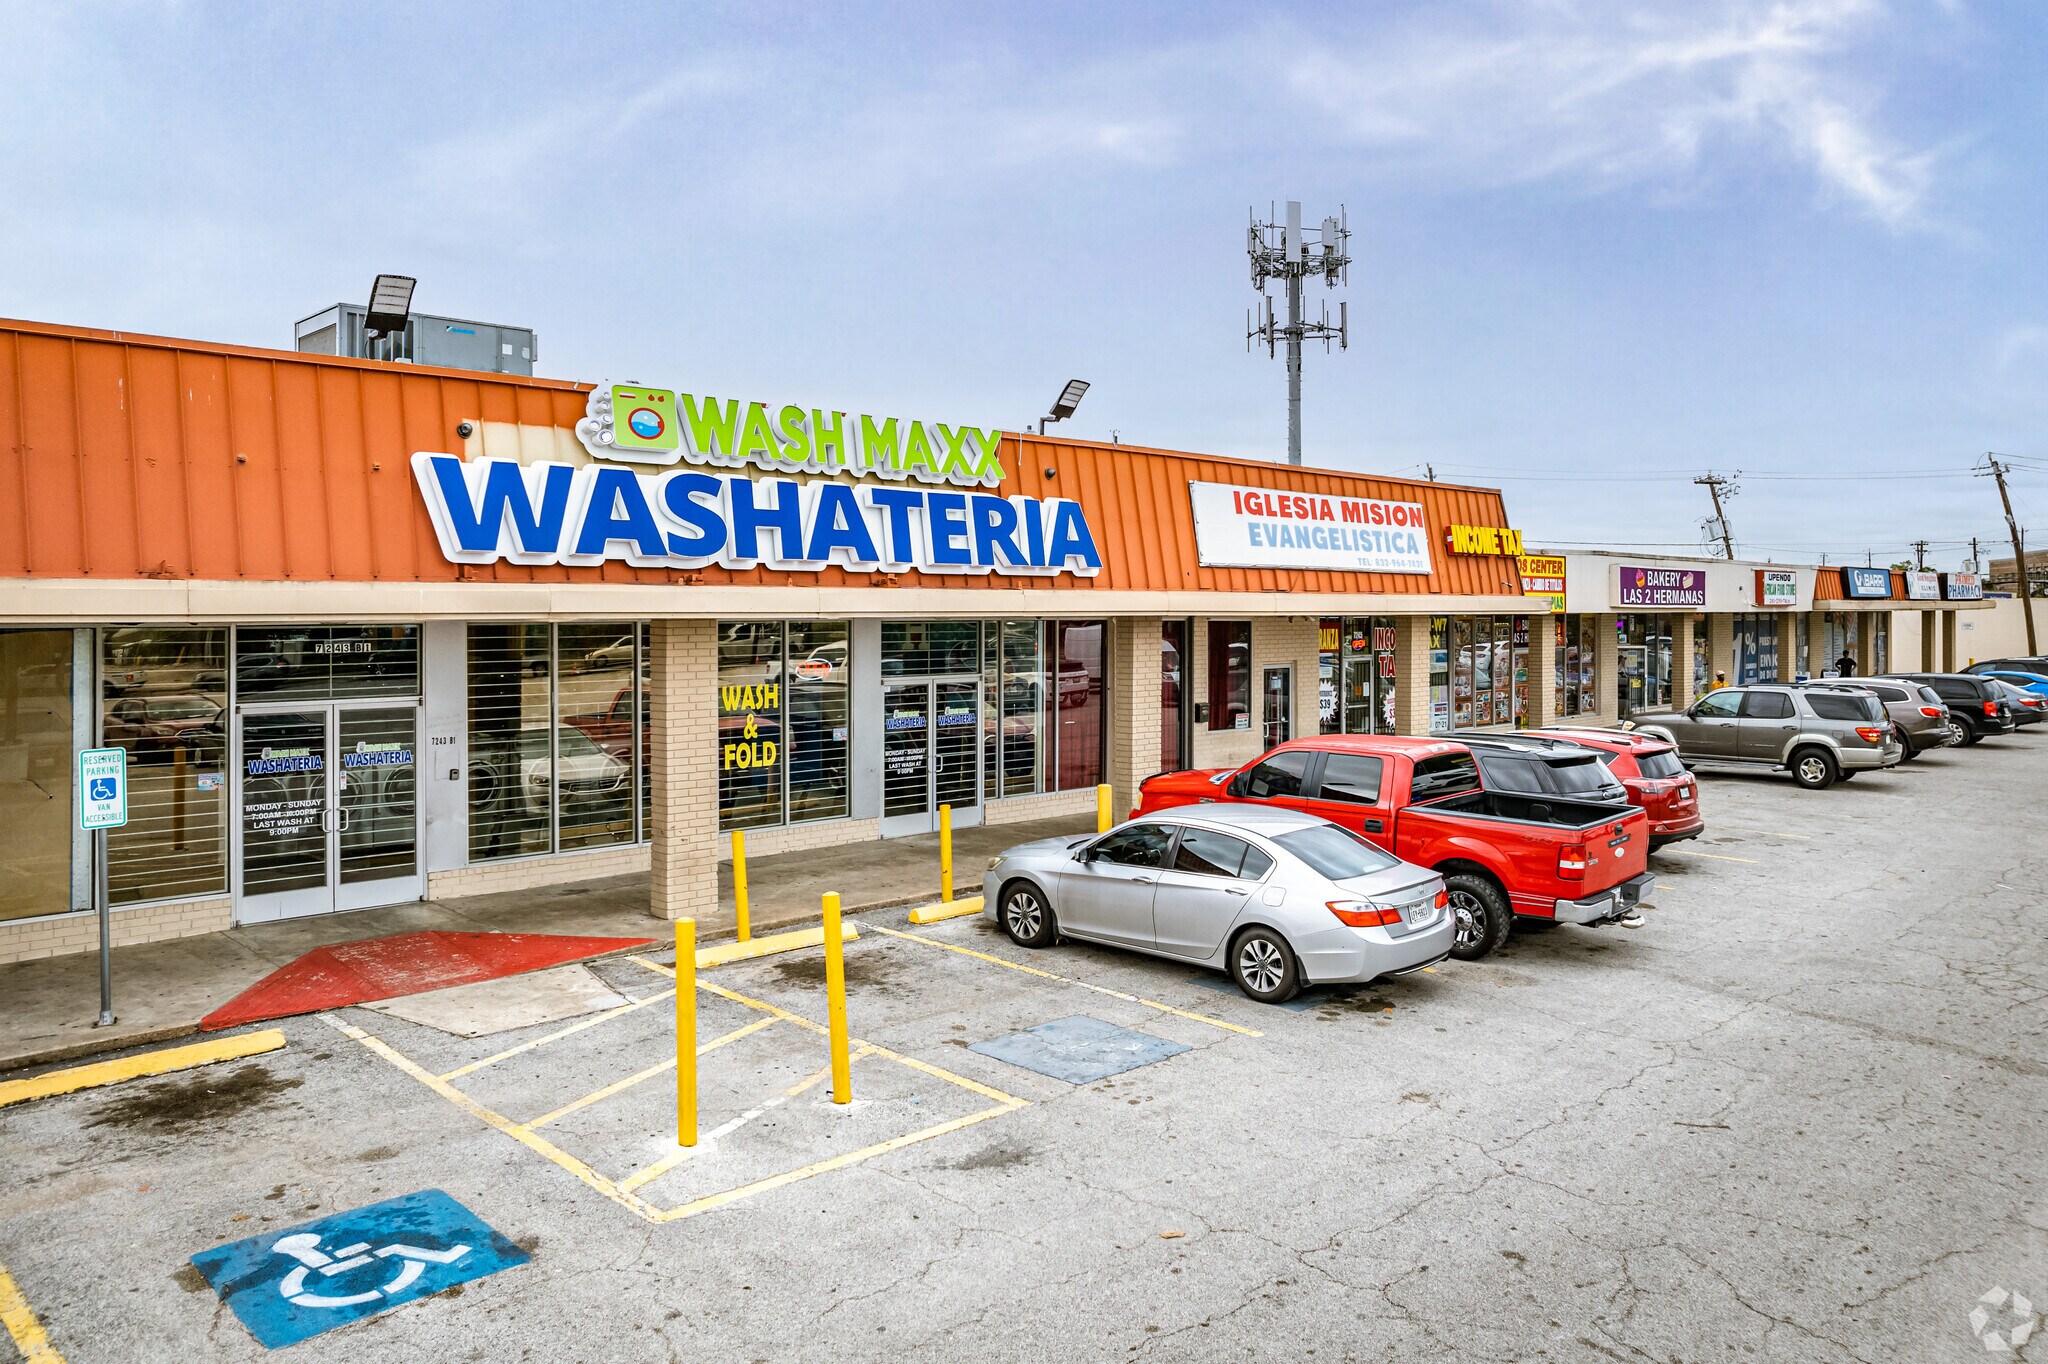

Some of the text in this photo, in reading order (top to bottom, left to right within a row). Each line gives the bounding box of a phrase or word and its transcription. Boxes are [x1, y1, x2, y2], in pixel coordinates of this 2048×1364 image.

[680, 393, 1006, 480] WASH MAXX
[428, 456, 1104, 570] WASHATERIA
[1233, 490, 1424, 528] IGLESIA MISION
[1247, 522, 1419, 555] EVANGELISTICA
[1450, 524, 1526, 556] INCOME TAX
[1358, 557, 1373, 567] TEL:
[1530, 558, 1563, 575] CENTER
[1647, 570, 1681, 587] BAKERY
[1768, 573, 1791, 582] UPENDO
[1623, 588, 1704, 605] LAS 2 HERMANAS
[1948, 584, 1981, 599] PHARMACY
[1374, 627, 1396, 651] INCO
[315, 642, 350, 654] 7243
[1378, 654, 1396, 678] TA
[721, 683, 779, 712] WASH
[743, 713, 758, 740] &
[886, 716, 926, 730] WASHATERIA
[938, 712, 977, 727] WASHATERIA
[431, 736, 447, 745] 7243
[83, 753, 122, 765] RESERVED
[344, 750, 413, 767] WASHATERIA
[724, 740, 777, 771] FOLD
[86, 765, 120, 776] PARKING
[248, 756, 323, 775] WASHATERIA
[97, 803, 111, 811] VAN
[245, 802, 282, 812] MONDAY
[288, 799, 322, 809] SUNDAY
[85, 812, 123, 823] ACCESSIBLE
[253, 816, 315, 829] LAST WASH AT
[269, 827, 299, 836] 9:00PM
